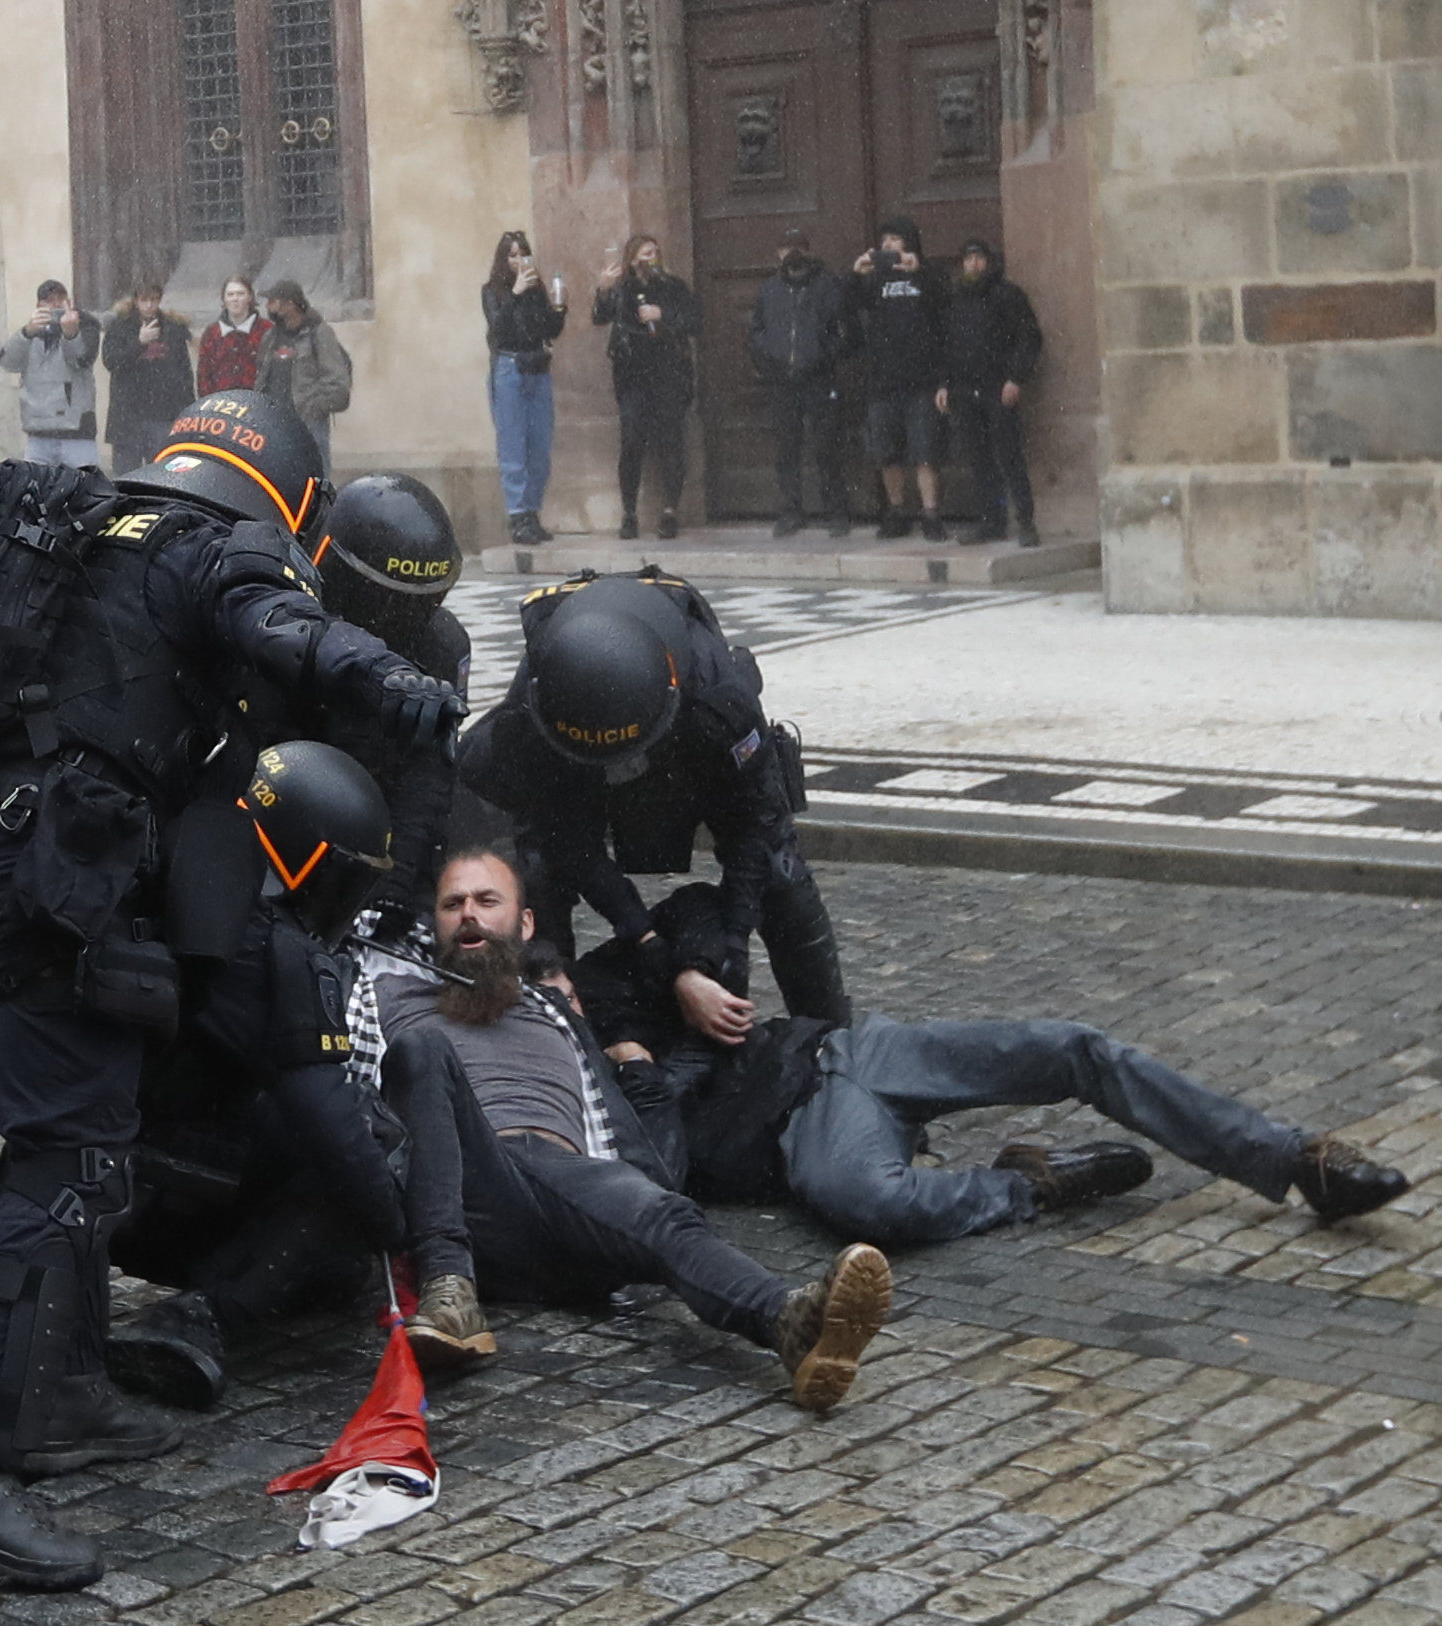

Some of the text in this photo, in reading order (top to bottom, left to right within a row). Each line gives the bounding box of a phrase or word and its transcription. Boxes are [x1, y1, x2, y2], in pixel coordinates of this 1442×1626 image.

[213, 399, 249, 419] 121
[168, 416, 266, 452] BRAVO 120
[386, 557, 451, 577] POLICIE
[251, 779, 277, 807] 120
[321, 1034, 333, 1051] B
